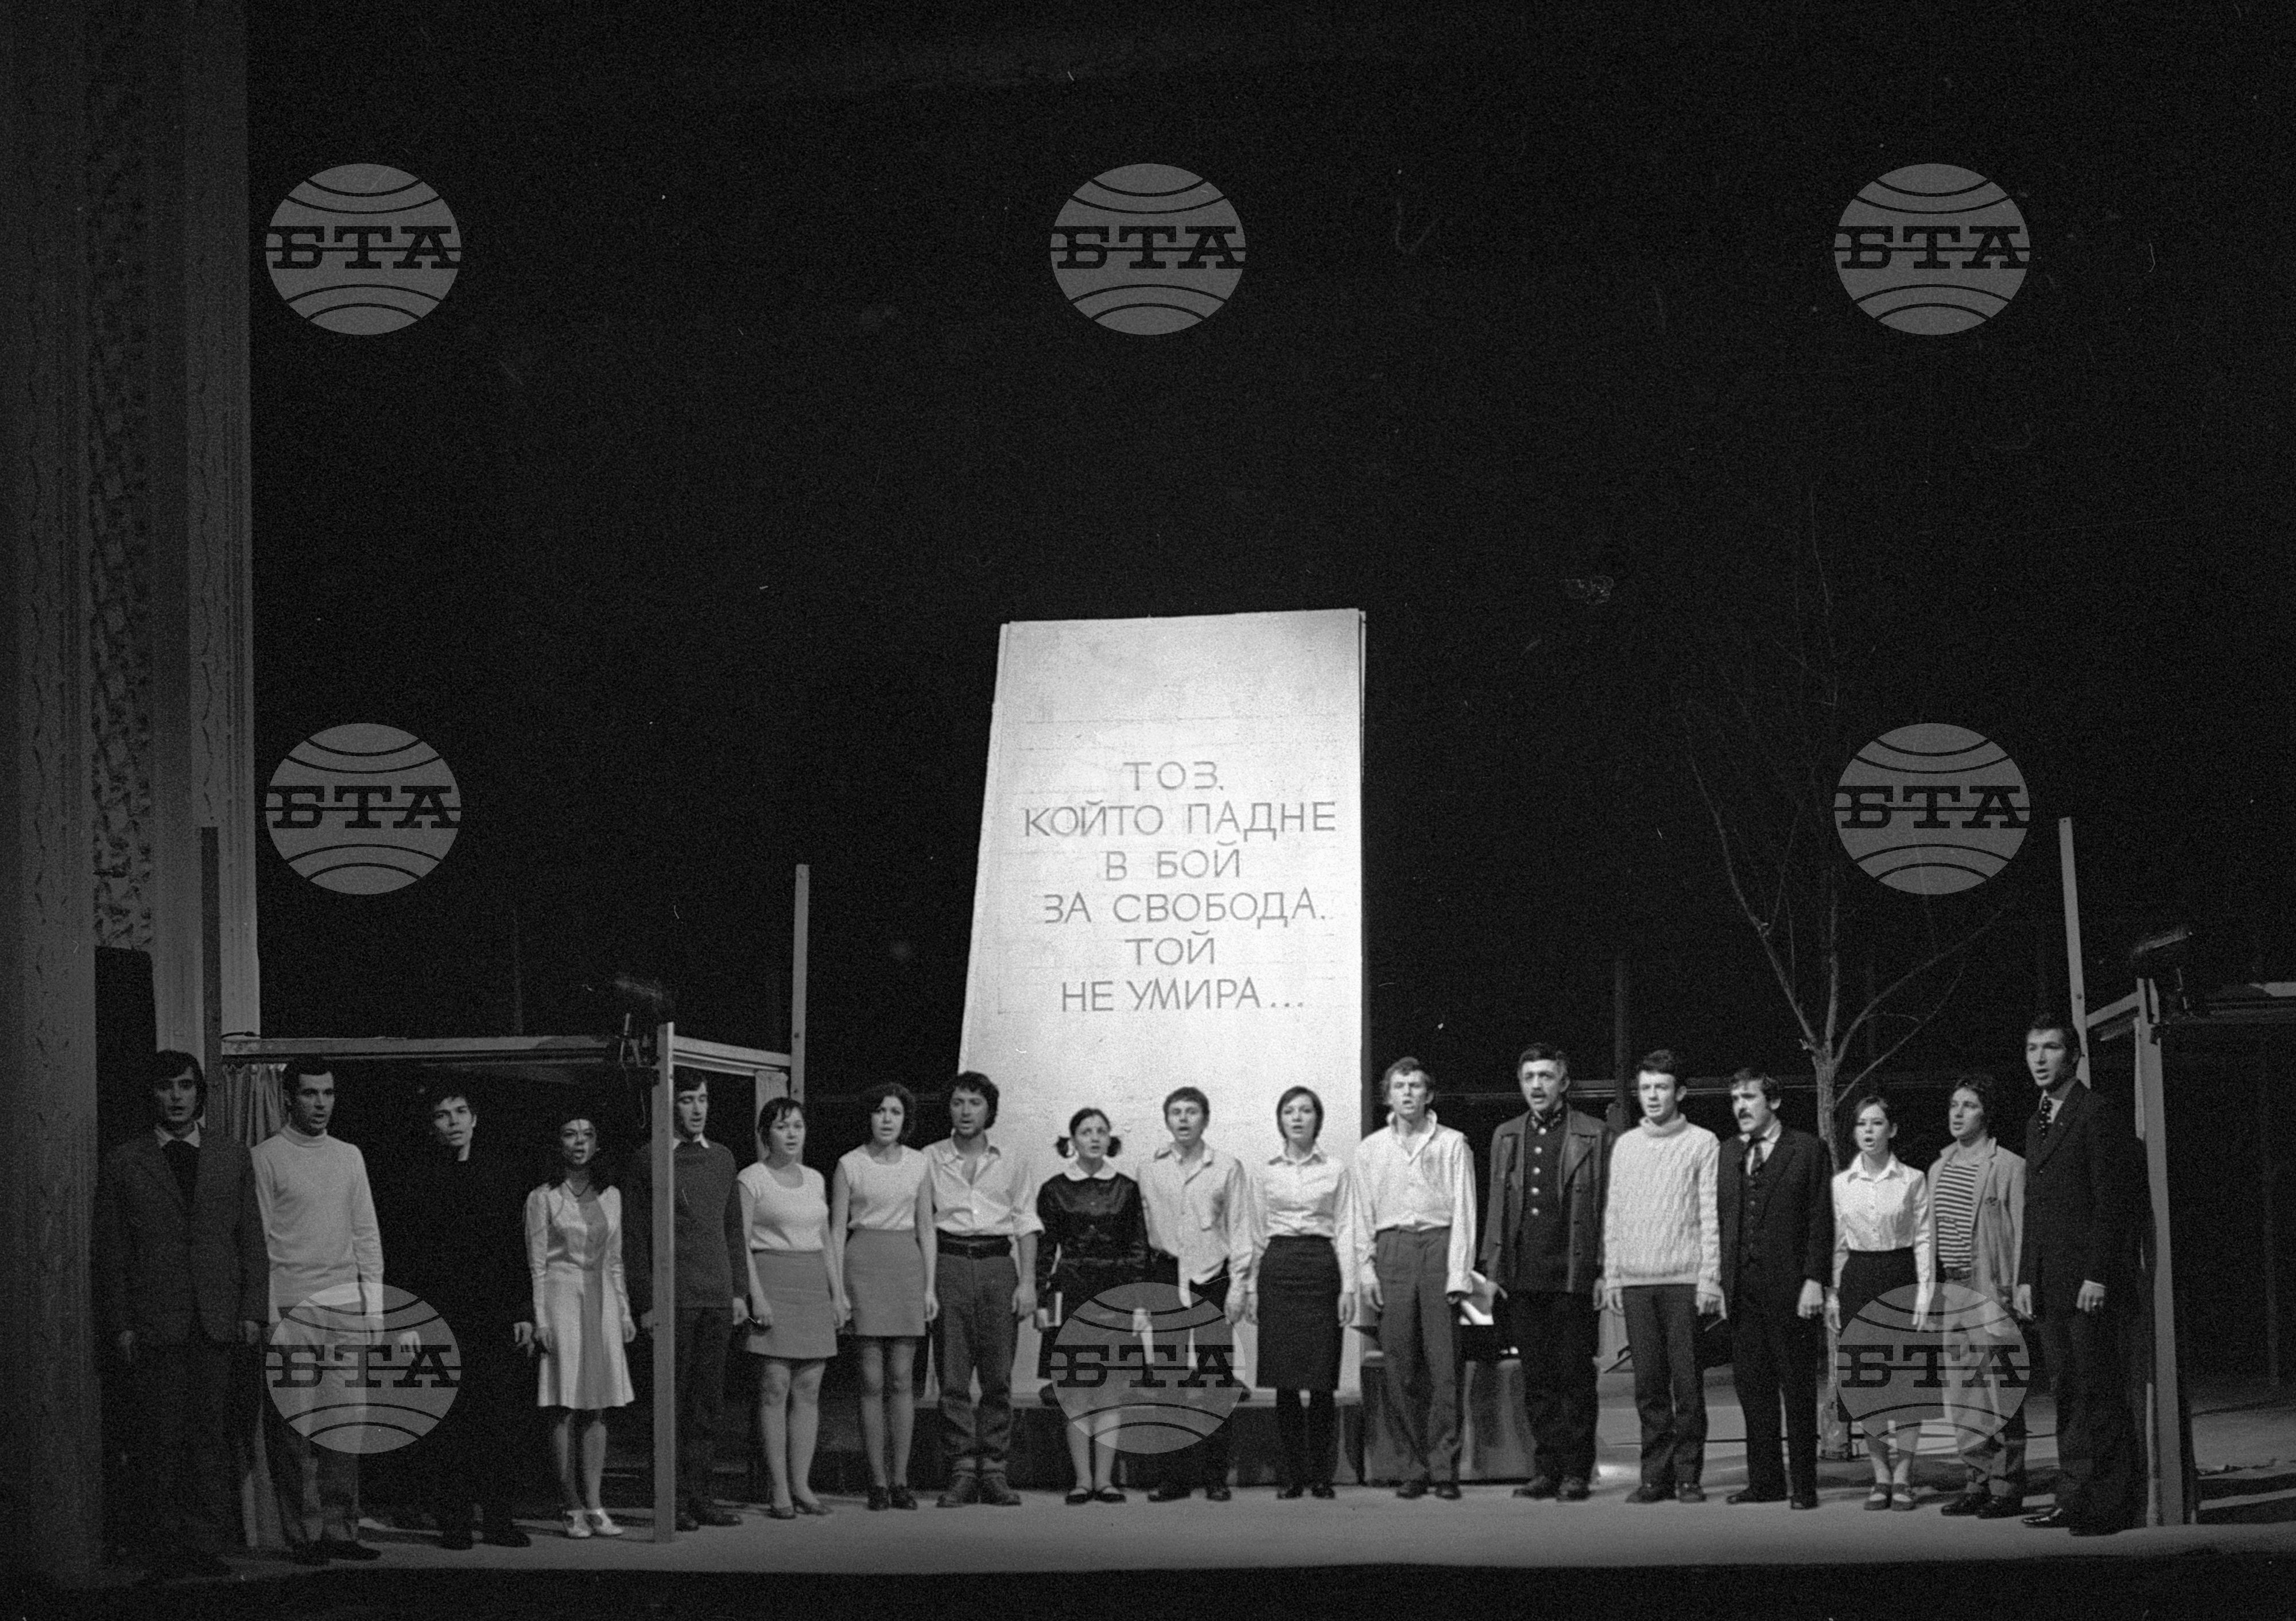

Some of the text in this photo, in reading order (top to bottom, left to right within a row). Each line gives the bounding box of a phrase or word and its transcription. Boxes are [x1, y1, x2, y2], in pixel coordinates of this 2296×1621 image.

[1025, 800, 1336, 842] КОЙТО ПАДНЕ
[1106, 840, 1240, 881] В БОЙ
[1044, 891, 1091, 924] ЗА
[1124, 930, 1215, 965] ТОЙ
[1062, 980, 1114, 1012] НЕ
